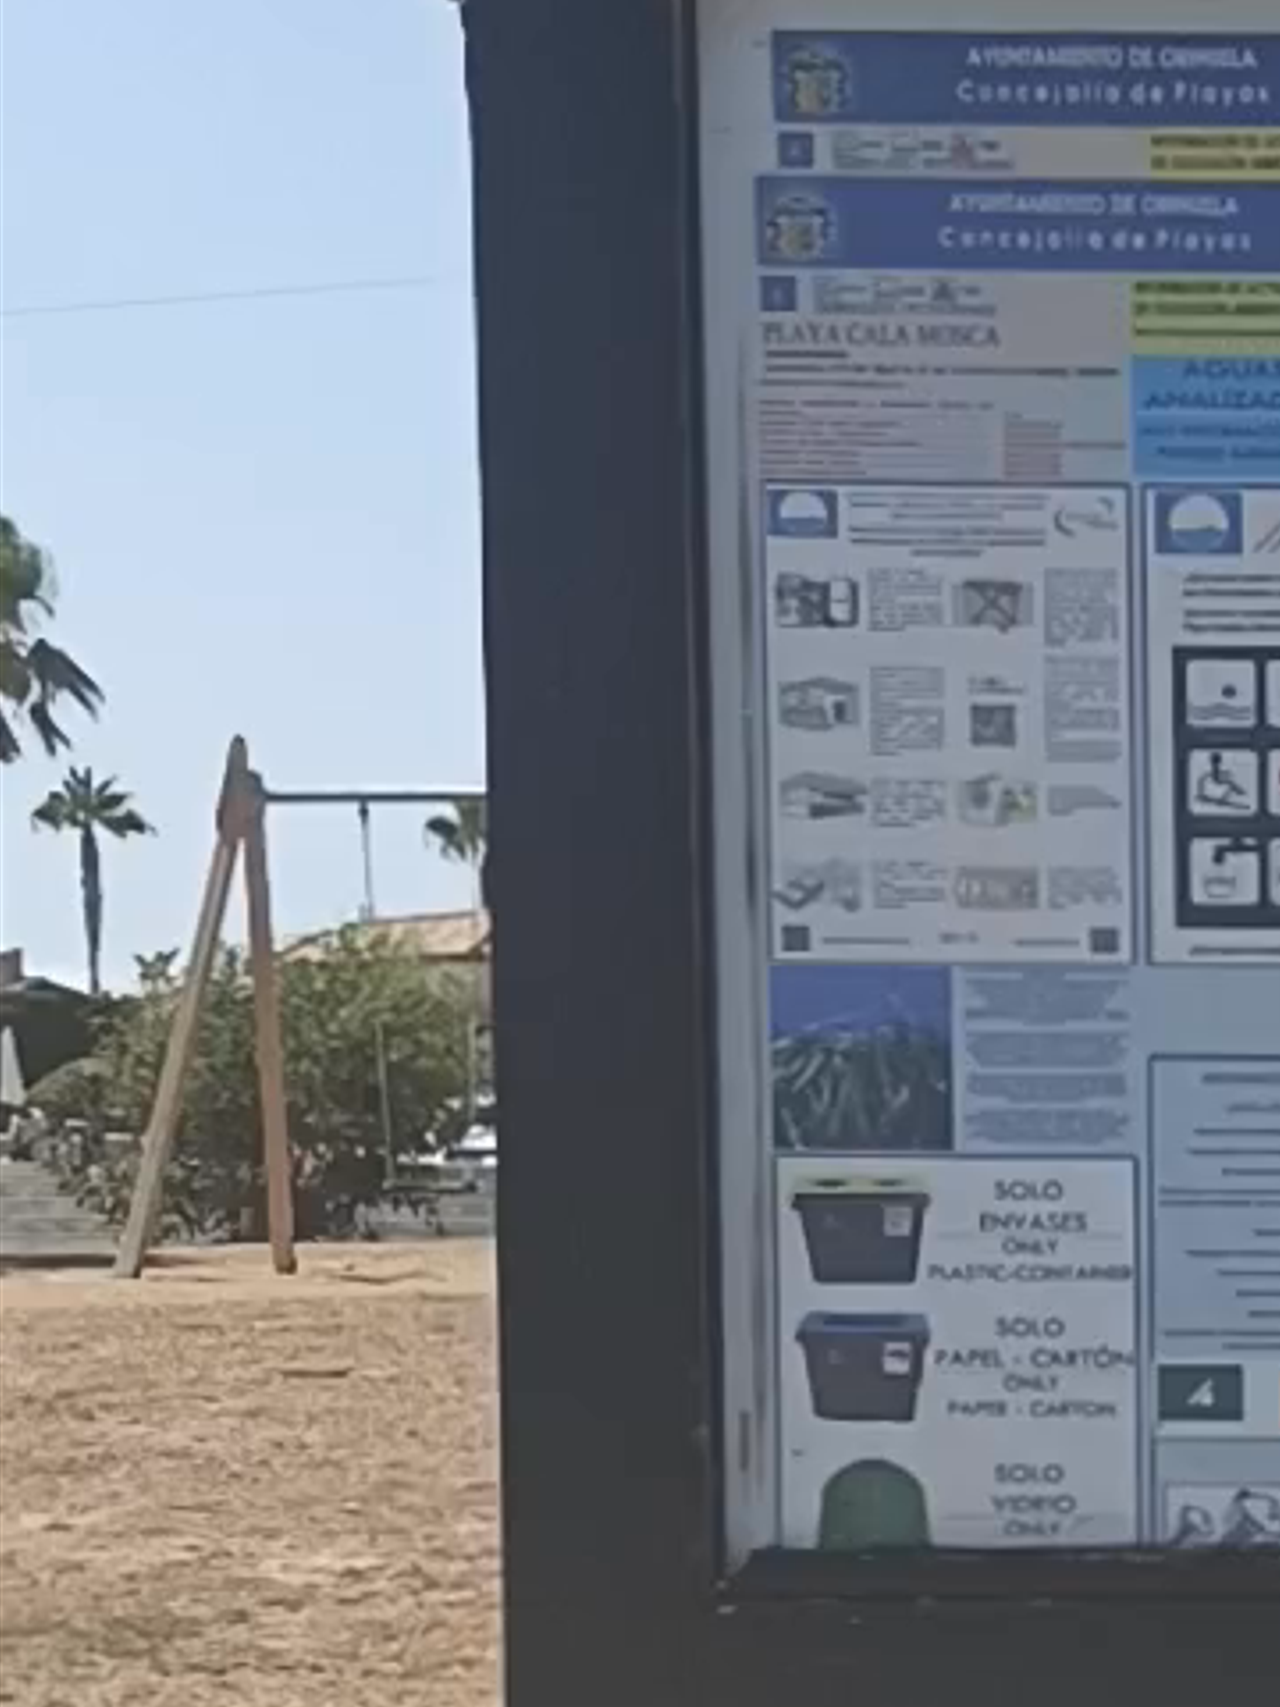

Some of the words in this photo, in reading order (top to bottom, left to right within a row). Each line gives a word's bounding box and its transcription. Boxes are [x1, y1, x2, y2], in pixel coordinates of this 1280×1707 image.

[1128, 81, 1165, 104] de
[1173, 80, 1271, 107] Playas
[1110, 227, 1147, 251] de
[993, 1177, 1065, 1202] SOLO
[979, 1211, 1088, 1233] ENVASES
[1001, 1236, 1059, 1256] ONLY
[994, 1315, 1066, 1338] SOLO
[934, 1348, 1004, 1369] PAPEL
[1001, 1373, 1059, 1394] ONLY
[993, 1462, 1066, 1484] SOLO
[990, 1493, 1078, 1515] VIDRIO
